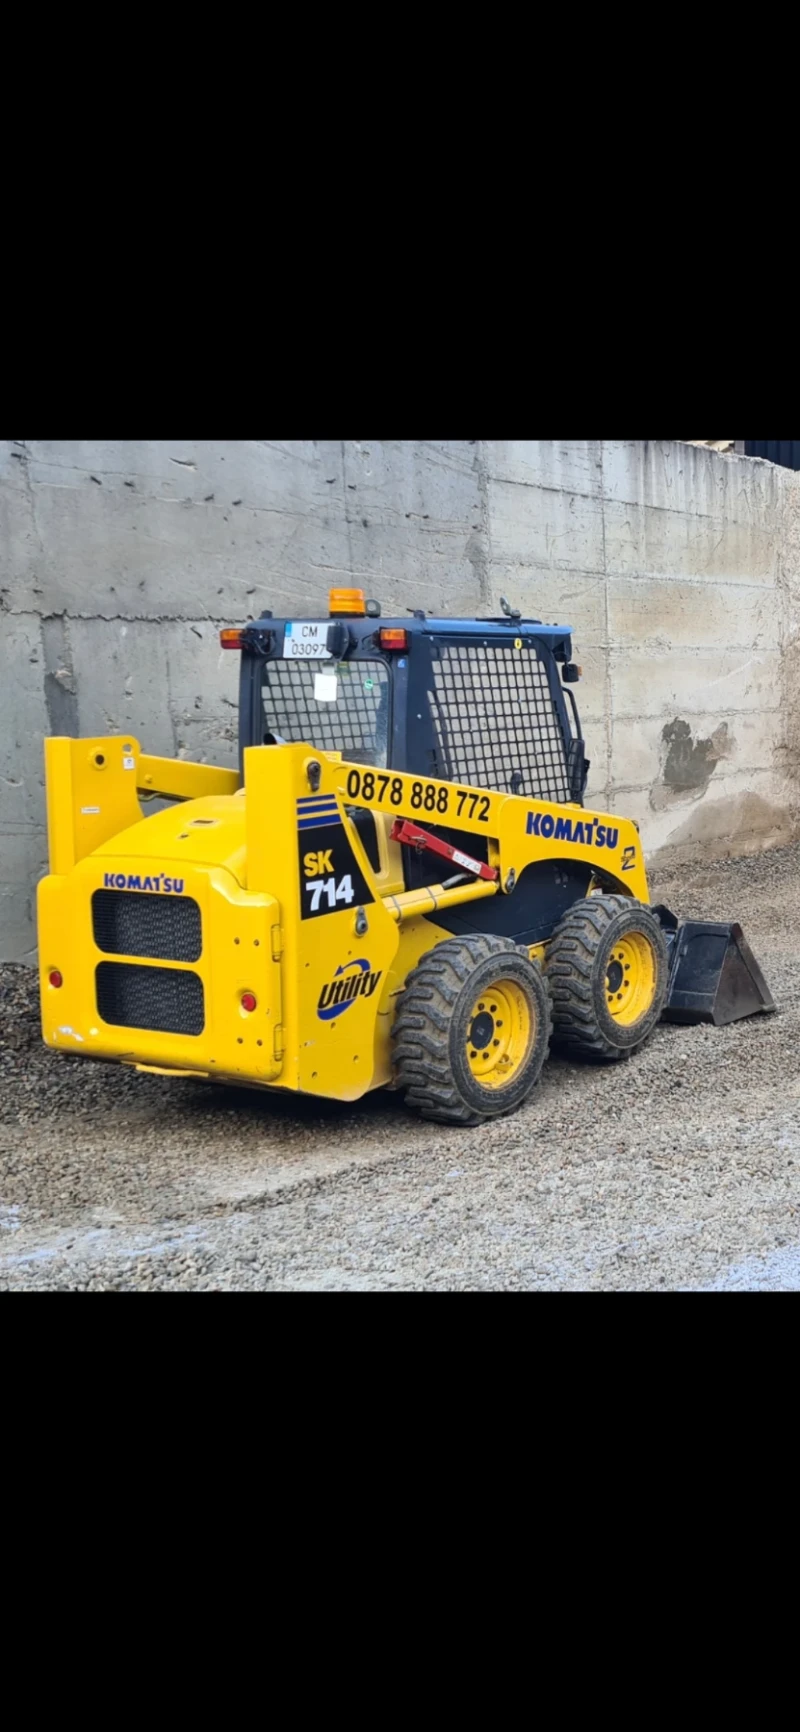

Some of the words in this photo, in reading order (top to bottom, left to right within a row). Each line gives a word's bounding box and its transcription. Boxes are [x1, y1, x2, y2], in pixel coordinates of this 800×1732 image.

[302, 626, 318, 637] CM
[347, 769, 403, 806] 0878
[410, 782, 449, 813] 888
[456, 790, 491, 822] 772
[525, 811, 619, 849] KOMATSU
[303, 848, 335, 877] SK
[104, 873, 184, 893] KOMATSU
[305, 874, 354, 911] 714
[317, 970, 383, 1009] Utility
